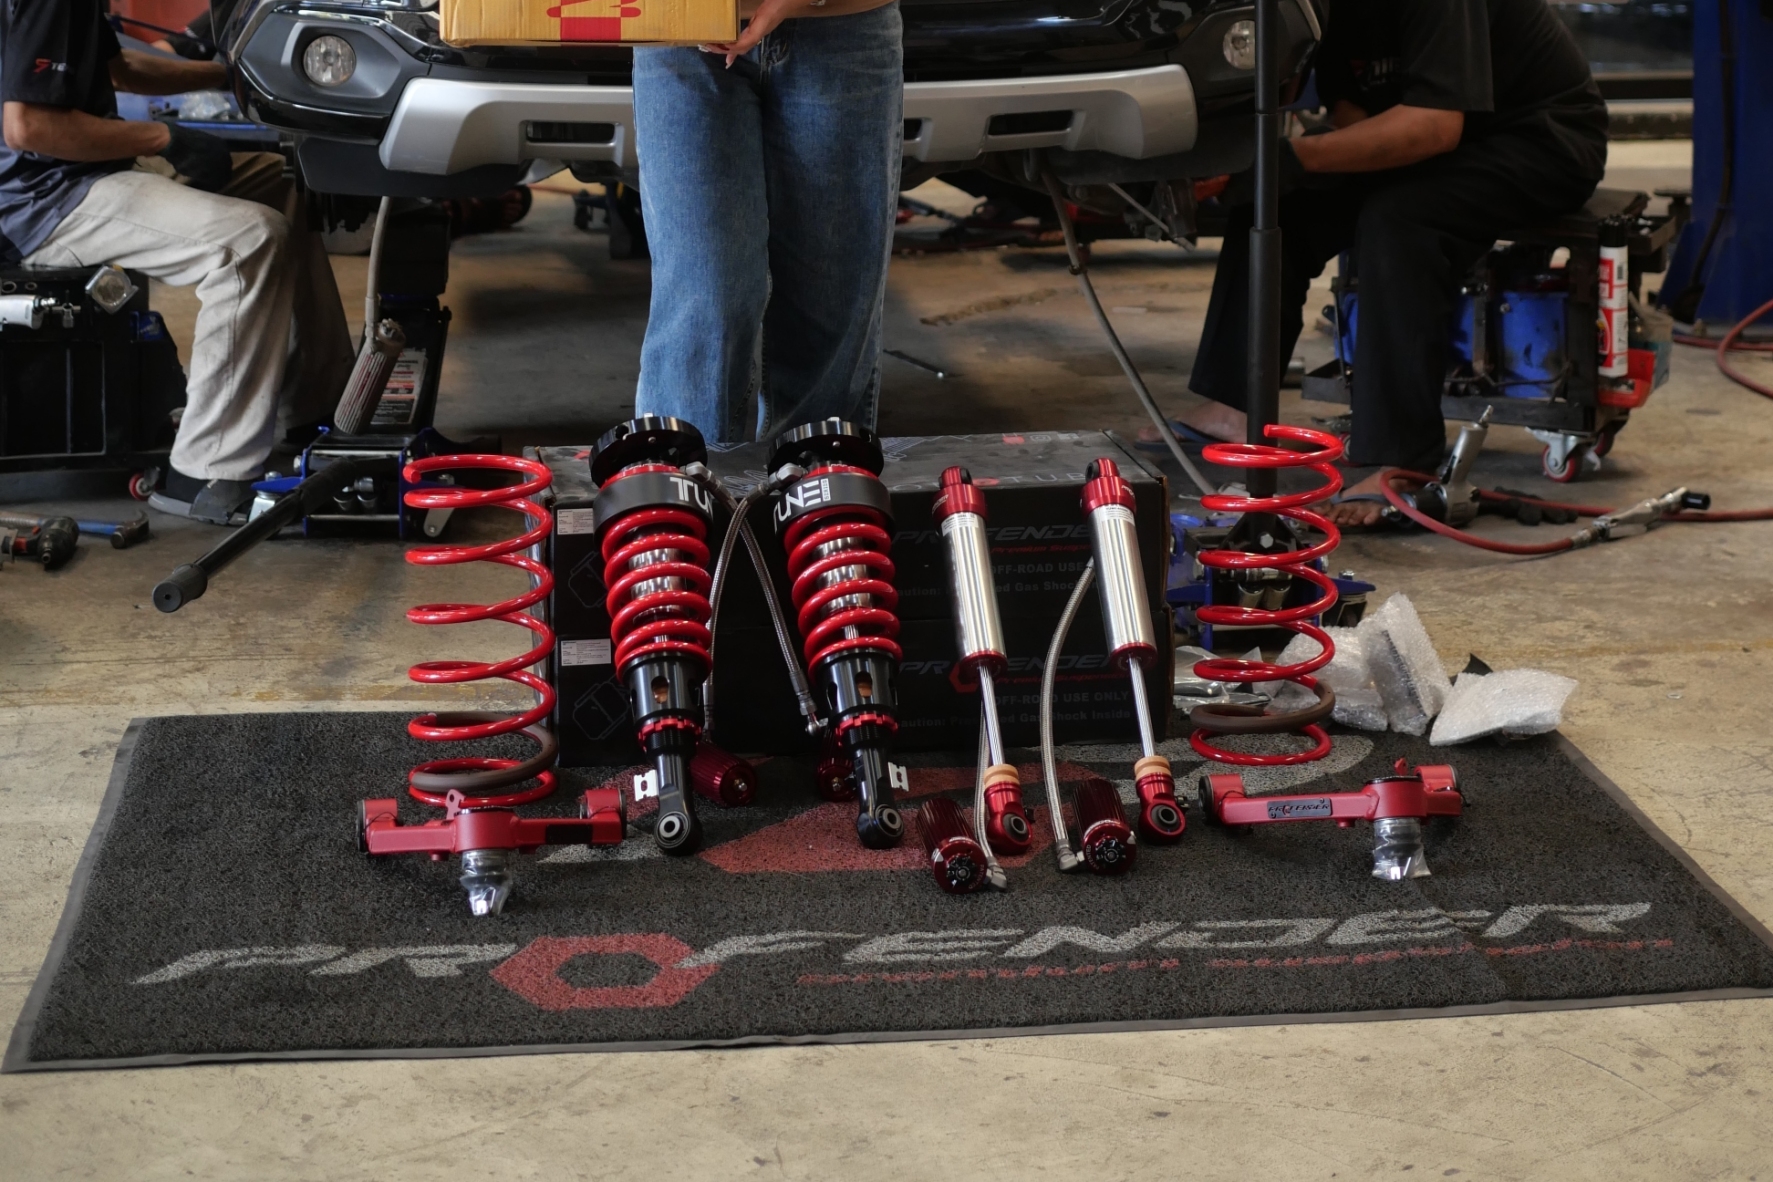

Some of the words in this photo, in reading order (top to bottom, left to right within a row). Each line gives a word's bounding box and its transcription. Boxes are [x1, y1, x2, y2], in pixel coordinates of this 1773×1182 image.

[1043, 579, 1078, 592] Shoc
[1063, 691, 1090, 703] USE
[1094, 690, 1130, 702] ONLY
[131, 902, 1653, 1011] PROFENDER
